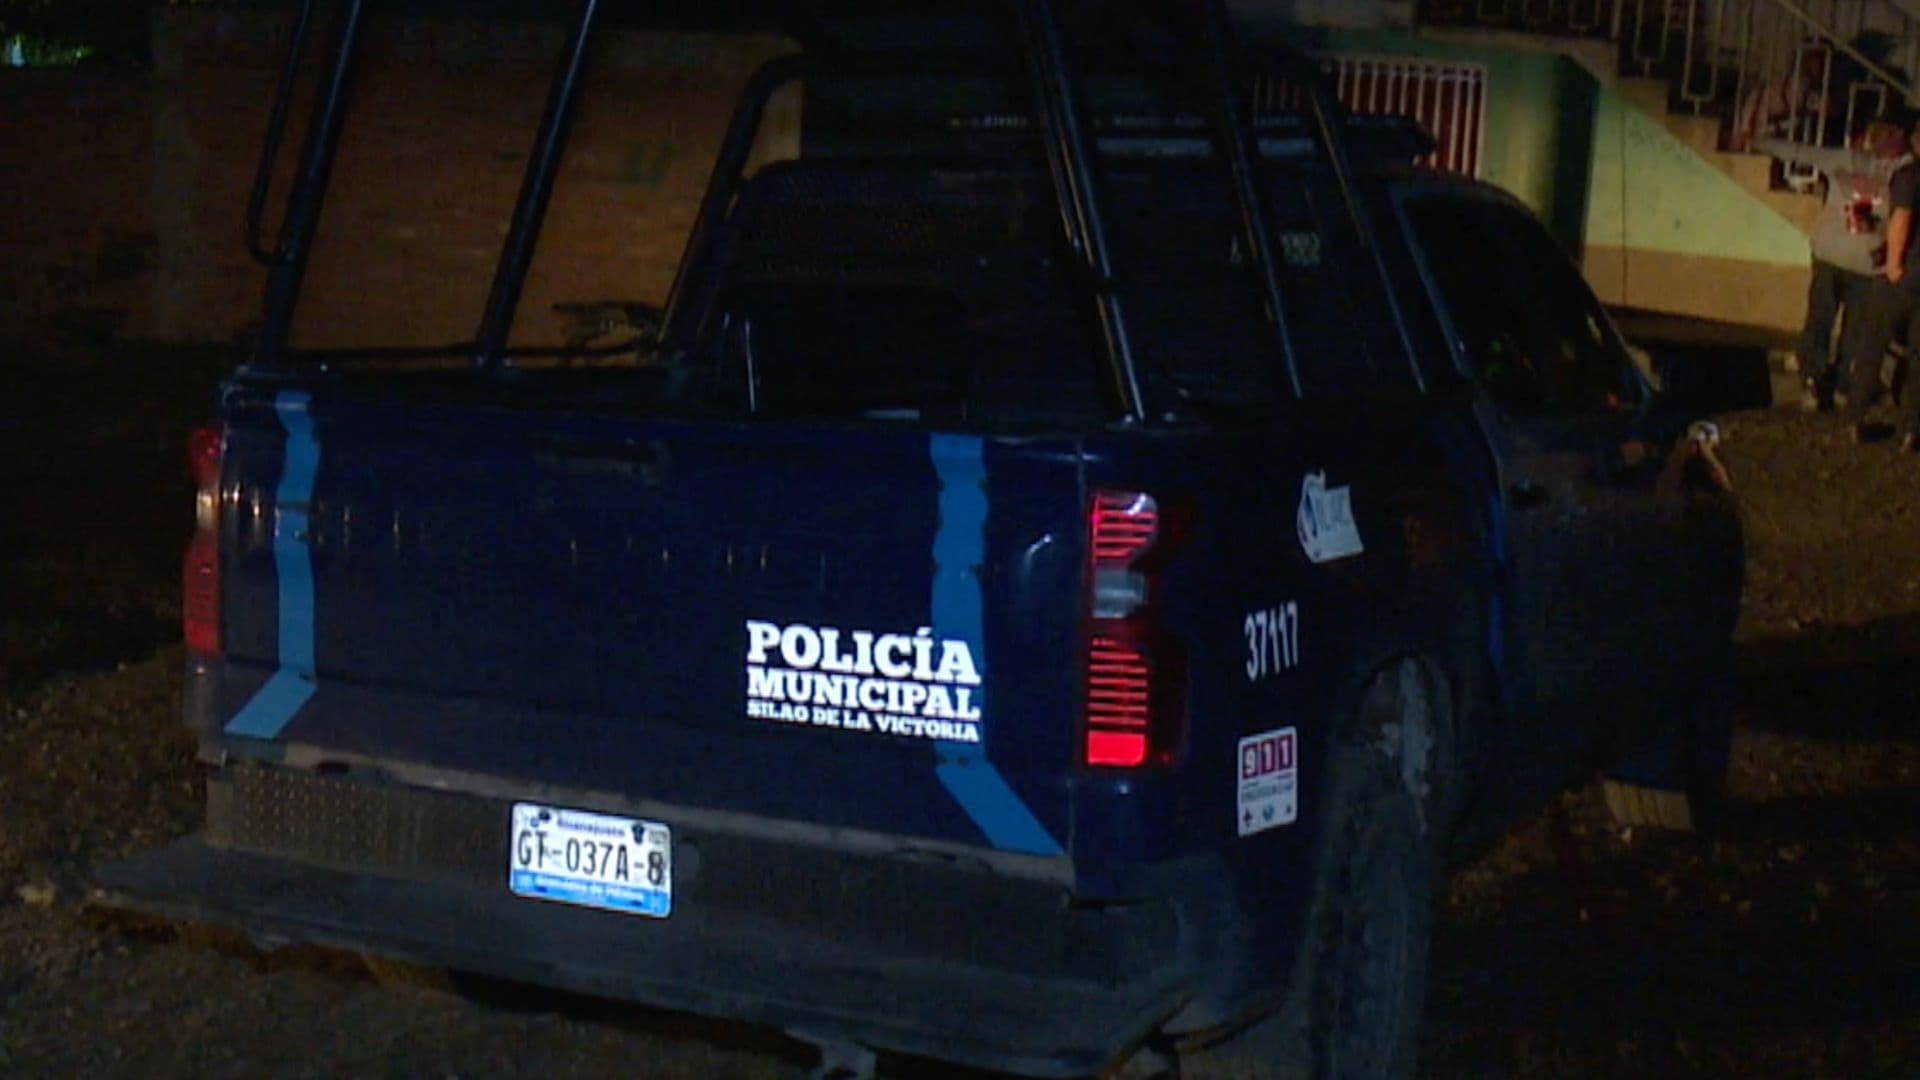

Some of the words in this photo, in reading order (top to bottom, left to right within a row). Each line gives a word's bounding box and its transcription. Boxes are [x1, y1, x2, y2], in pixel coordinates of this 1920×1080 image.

[746, 620, 981, 684] POLICÍA
[1244, 600, 1298, 681] 37117
[746, 665, 981, 721] MUNICIPAL
[747, 700, 809, 723] SILAO
[813, 706, 839, 727] DE
[843, 710, 872, 731] LA
[874, 714, 979, 742] VICTORIA
[1243, 736, 1293, 778] 911
